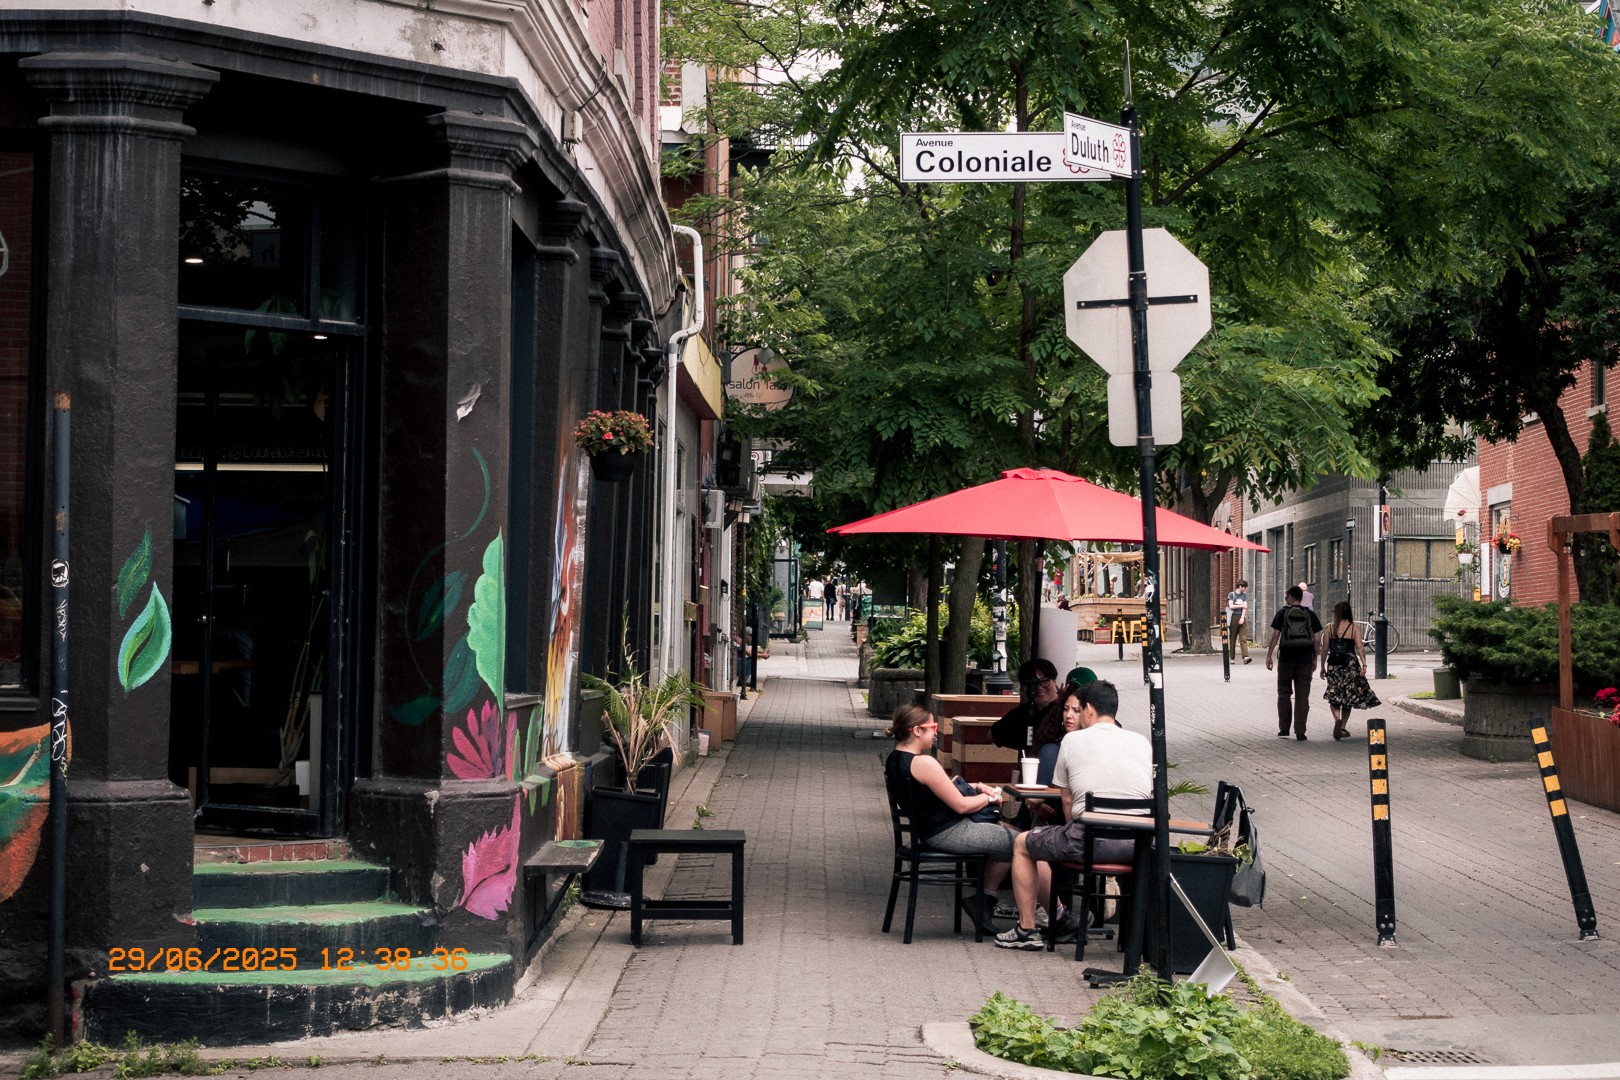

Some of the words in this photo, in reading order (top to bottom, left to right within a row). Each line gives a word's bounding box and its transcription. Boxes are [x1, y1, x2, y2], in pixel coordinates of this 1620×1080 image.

[1071, 120, 1086, 132] Avenue
[916, 138, 954, 147] Avenue
[1072, 132, 1109, 163] Duluth
[916, 150, 1052, 173] Coloniale
[729, 378, 760, 390] salon
